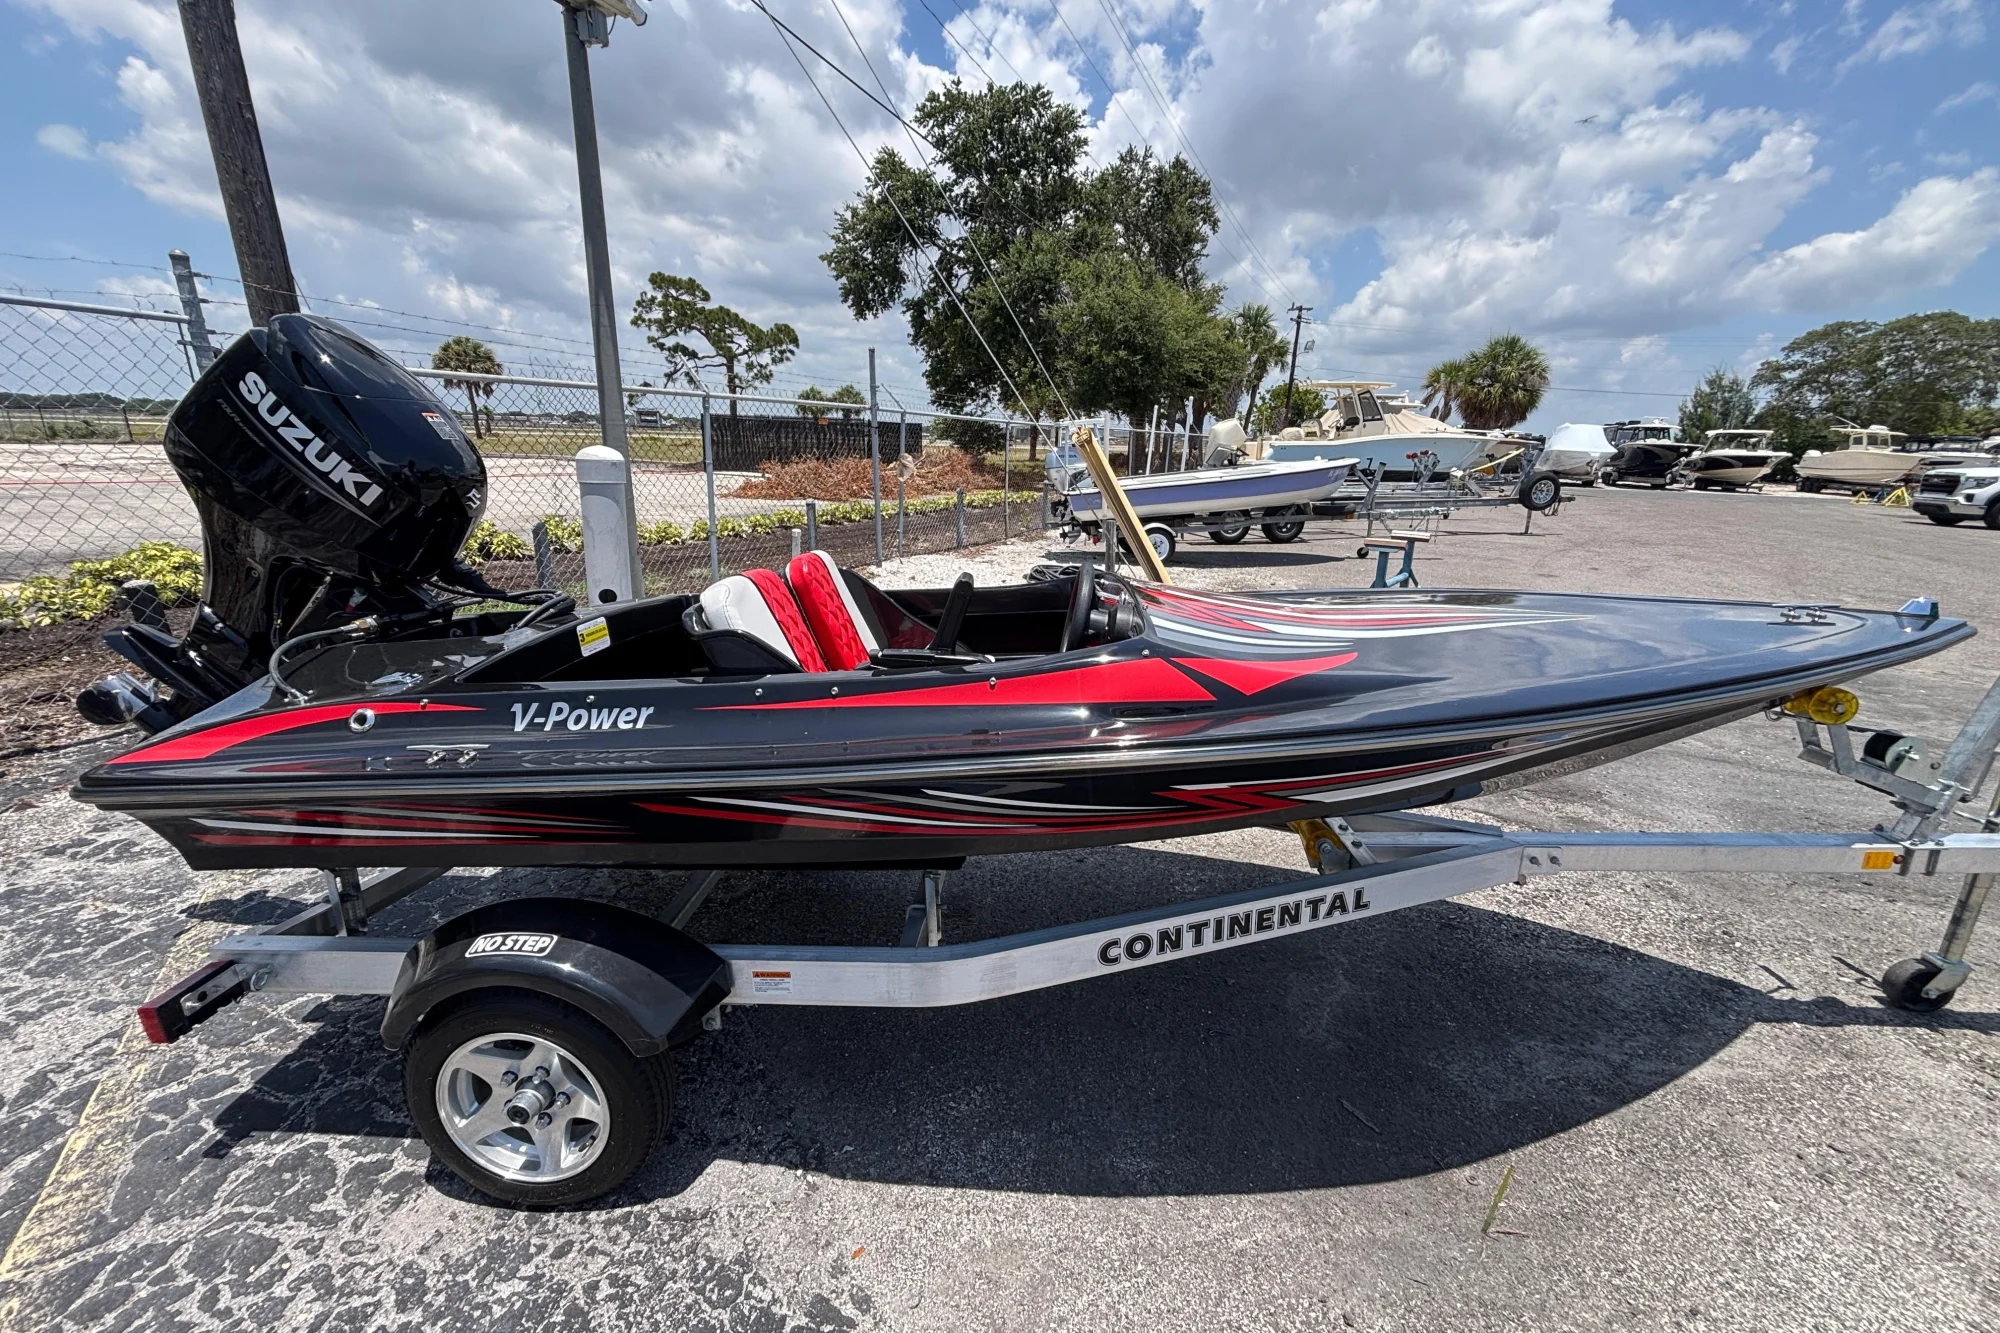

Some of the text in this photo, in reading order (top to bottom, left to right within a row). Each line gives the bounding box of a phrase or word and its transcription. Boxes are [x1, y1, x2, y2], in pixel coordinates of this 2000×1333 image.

[239, 372, 383, 507] SUZUKI
[579, 633, 586, 643] 3
[510, 702, 654, 732] V-Power
[1097, 887, 1371, 966] CONTINENTAL
[469, 935, 551, 953] NO STEP
